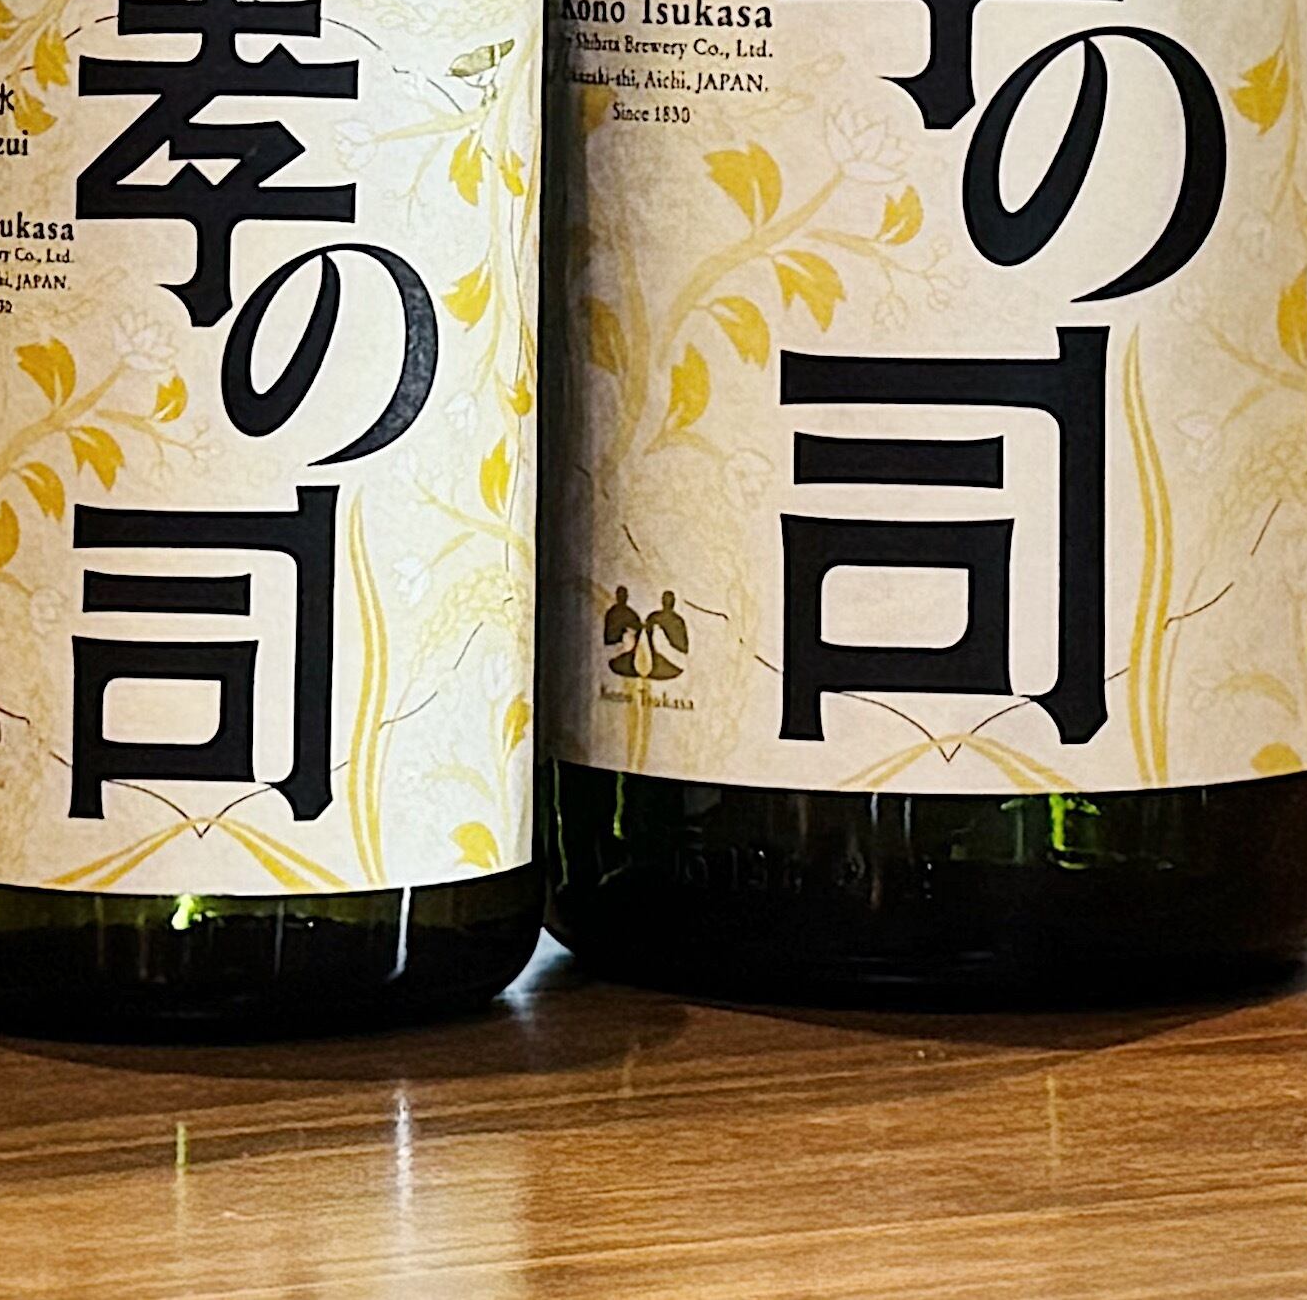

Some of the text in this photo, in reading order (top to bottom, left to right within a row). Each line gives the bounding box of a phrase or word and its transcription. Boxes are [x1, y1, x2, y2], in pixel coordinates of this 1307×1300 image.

[624, 34, 687, 60] Brewery
[694, 38, 730, 59] Co.,
[737, 39, 773, 58] Ltd.
[695, 72, 769, 94] JAPAN.
[613, 102, 690, 123] Since 1830
